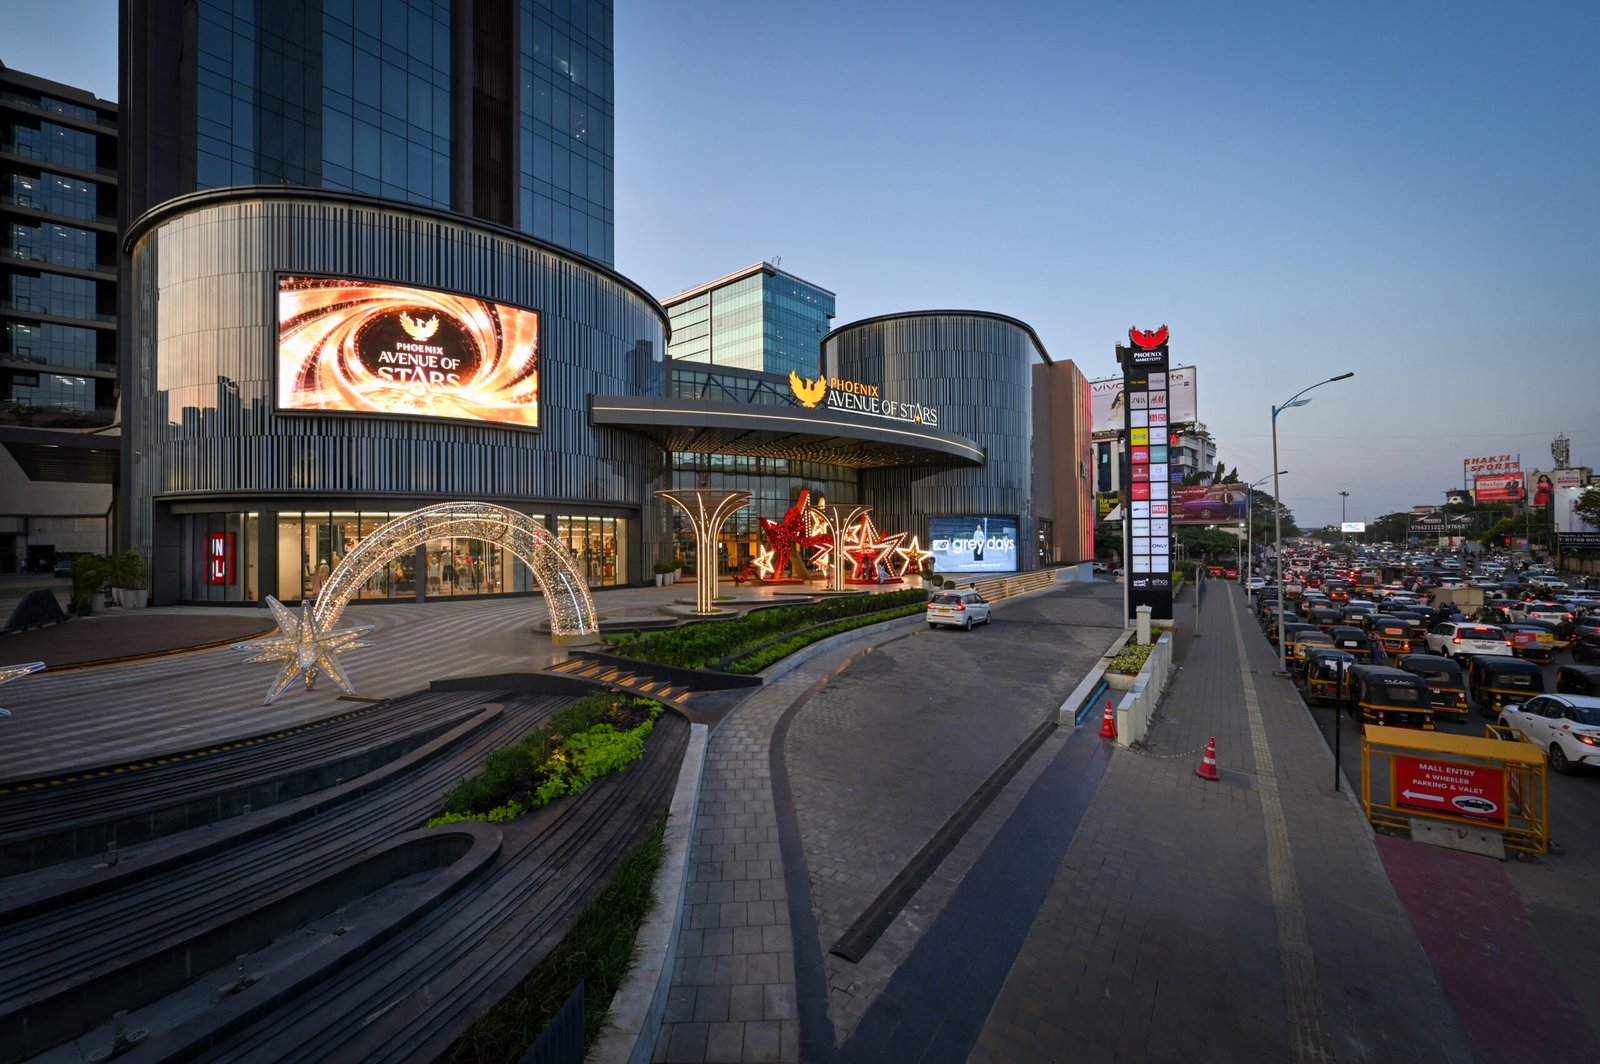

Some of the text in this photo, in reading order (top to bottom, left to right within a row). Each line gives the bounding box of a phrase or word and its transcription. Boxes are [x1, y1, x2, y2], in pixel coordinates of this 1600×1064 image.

[396, 342, 444, 355] PHOENIX
[378, 351, 460, 370] AVENUE OF
[377, 366, 461, 389] STARS
[830, 377, 879, 397] PHOENIX
[827, 389, 938, 423] AVENUE OF STARS
[1464, 454, 1511, 465] SHAKTI
[1471, 461, 1520, 472] SPORTS
[952, 539, 984, 555] grey
[987, 535, 1015, 552] days
[1419, 763, 1475, 777] MALL ENTRY
[1412, 778, 1448, 789] PARKING
[1458, 785, 1484, 795] VALET
[1432, 774, 1469, 784] WHEELER
